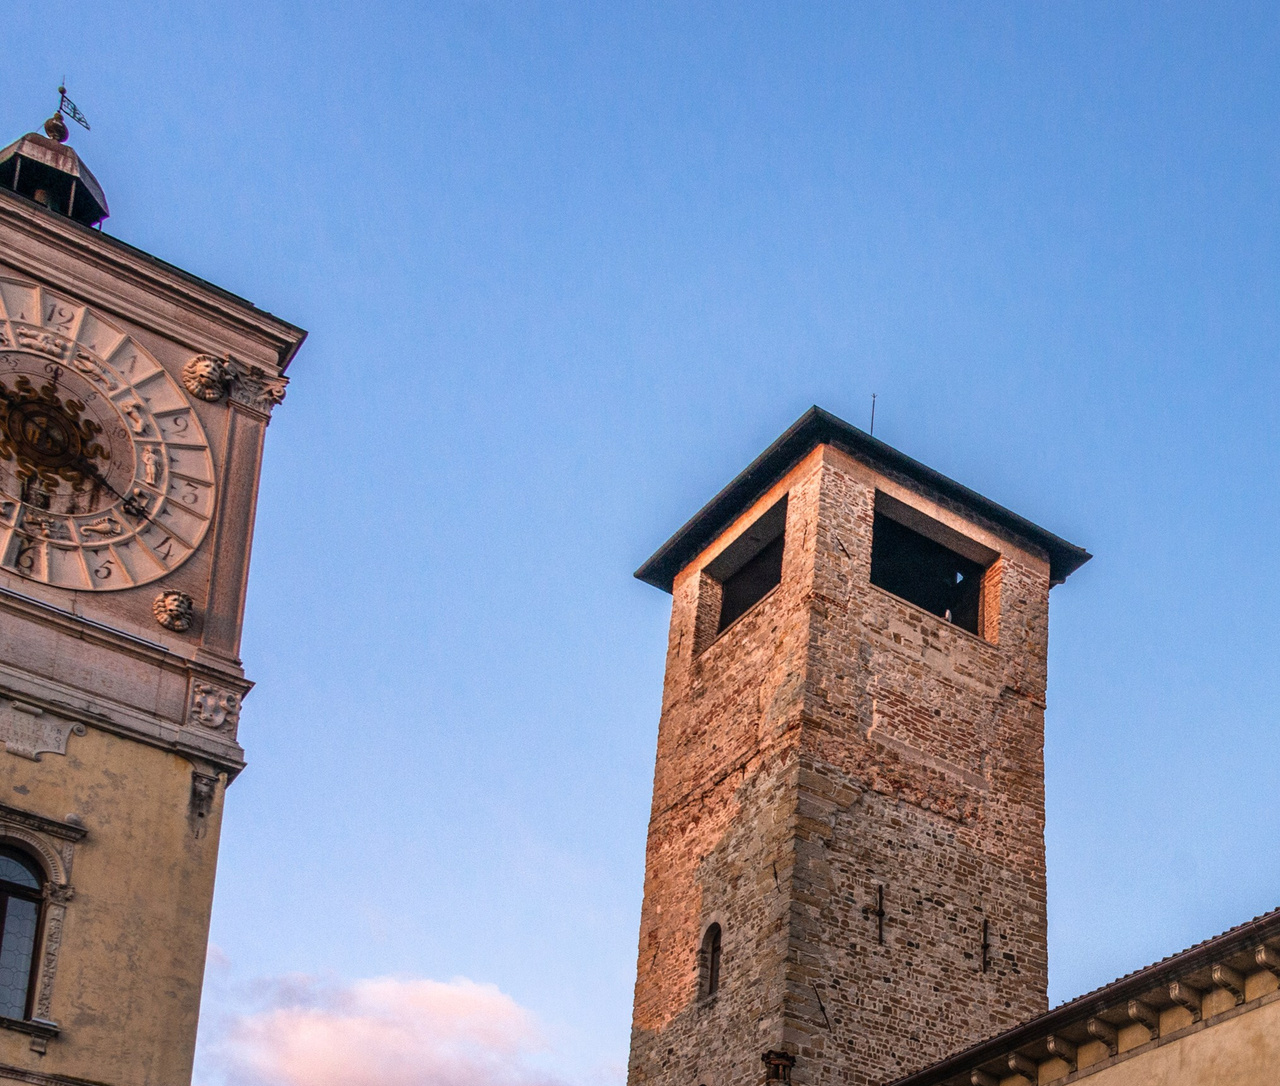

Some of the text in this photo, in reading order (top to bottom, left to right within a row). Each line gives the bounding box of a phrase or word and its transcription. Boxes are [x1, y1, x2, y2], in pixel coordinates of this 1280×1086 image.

[47, 304, 75, 330] 12
[112, 426, 127, 440] 10
[172, 416, 190, 439] 2
[182, 481, 199, 505] 3
[17, 546, 40, 569] 6
[153, 536, 174, 561] 4
[94, 560, 115, 580] 5
